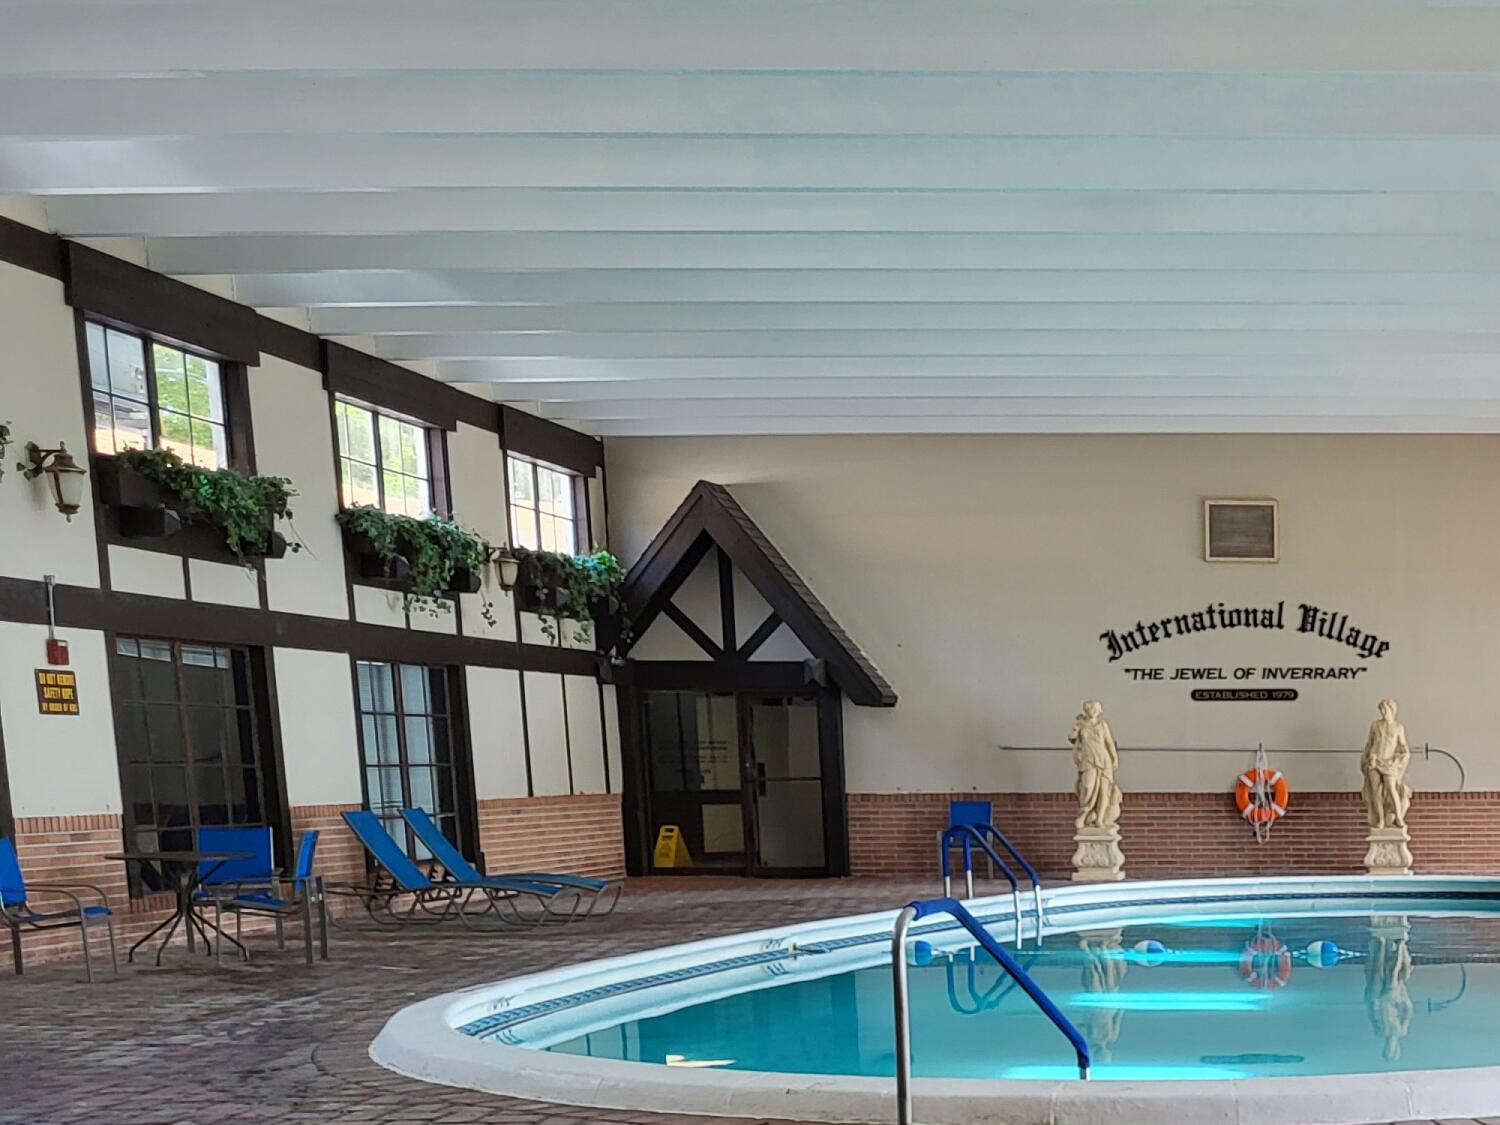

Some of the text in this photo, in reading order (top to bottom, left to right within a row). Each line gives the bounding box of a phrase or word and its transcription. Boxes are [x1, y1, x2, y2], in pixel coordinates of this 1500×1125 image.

[1099, 600, 1390, 663] International Village
[1124, 667, 1368, 681] "THE JEWEL OF INVERRARY"
[1195, 690, 1296, 700] ESTABLISHED 1979
